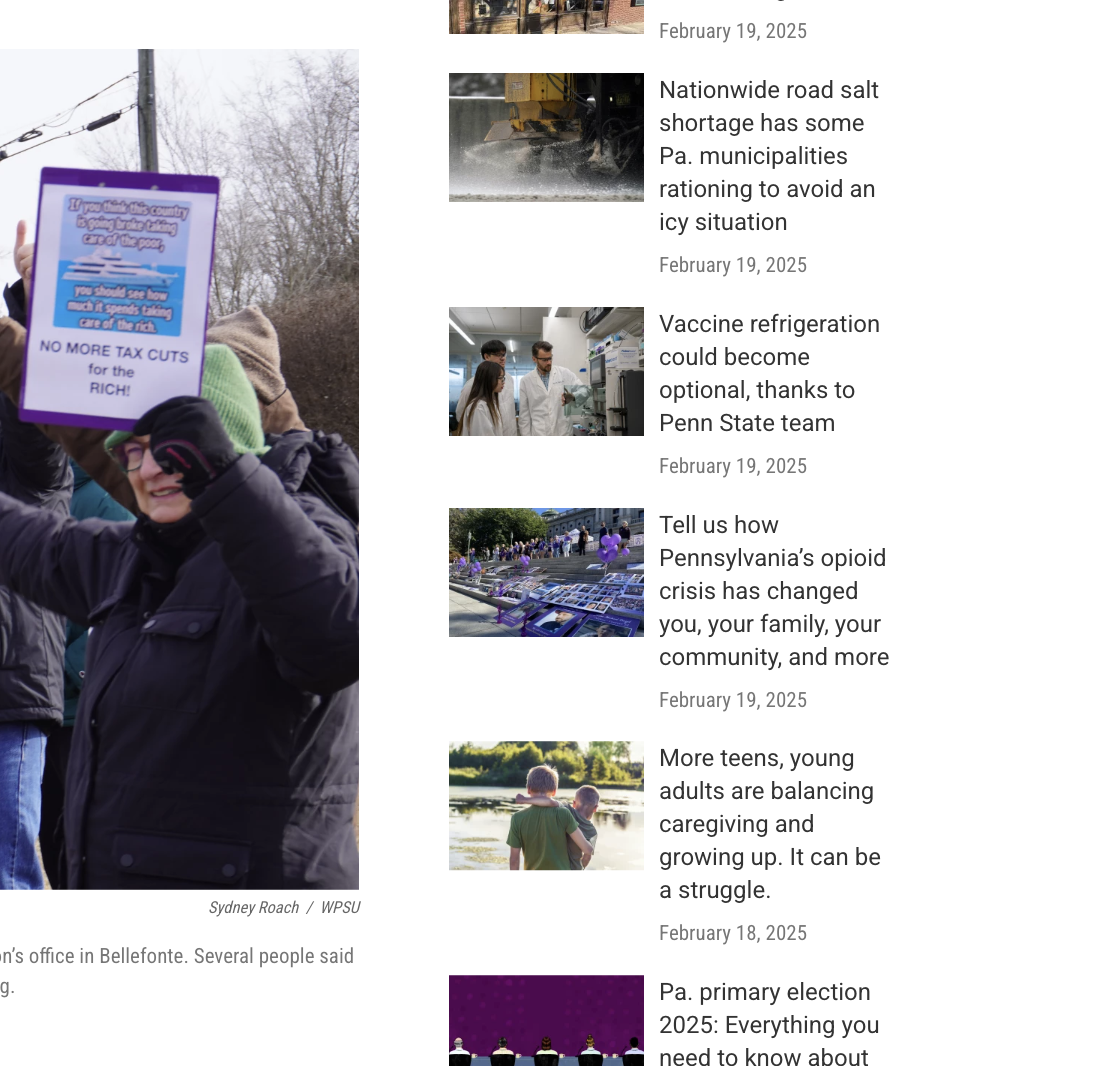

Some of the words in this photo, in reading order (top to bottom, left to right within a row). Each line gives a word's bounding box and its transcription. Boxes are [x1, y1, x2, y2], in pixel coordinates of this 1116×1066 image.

[68, 198, 82, 211] If
[83, 201, 101, 214] you
[103, 200, 127, 214] think
[129, 201, 149, 215] this
[150, 205, 189, 221] country
[77, 214, 86, 228] is
[87, 216, 114, 232] going
[115, 217, 144, 232] broke
[145, 220, 177, 237] taking
[83, 234, 104, 245] care
[105, 233, 118, 246] of
[120, 234, 137, 247] the
[137, 238, 164, 253] poor,
[74, 285, 93, 297] you
[93, 284, 126, 298] should
[127, 289, 145, 299] see
[146, 287, 168, 301] how
[67, 300, 93, 312] much
[95, 301, 103, 313] it
[105, 303, 139, 318] spends
[141, 304, 172, 321] taking
[79, 318, 100, 328] care
[102, 317, 115, 329] of
[117, 318, 133, 332] the
[135, 320, 157, 333] rich.
[659, 315, 743, 332] Vaccine
[751, 313, 879, 337] refrigeration
[40, 340, 62, 353] NO
[66, 342, 111, 357] MORE
[116, 346, 143, 359] TAX
[148, 349, 189, 363] CUTS
[88, 363, 108, 375] for
[112, 366, 134, 378] the
[90, 382, 130, 397] RICH!
[660, 885, 671, 898] a
[679, 880, 770, 903] struggle.
[209, 900, 256, 917] Sydney
[259, 900, 299, 913] Roach
[322, 901, 361, 913] WPSU
